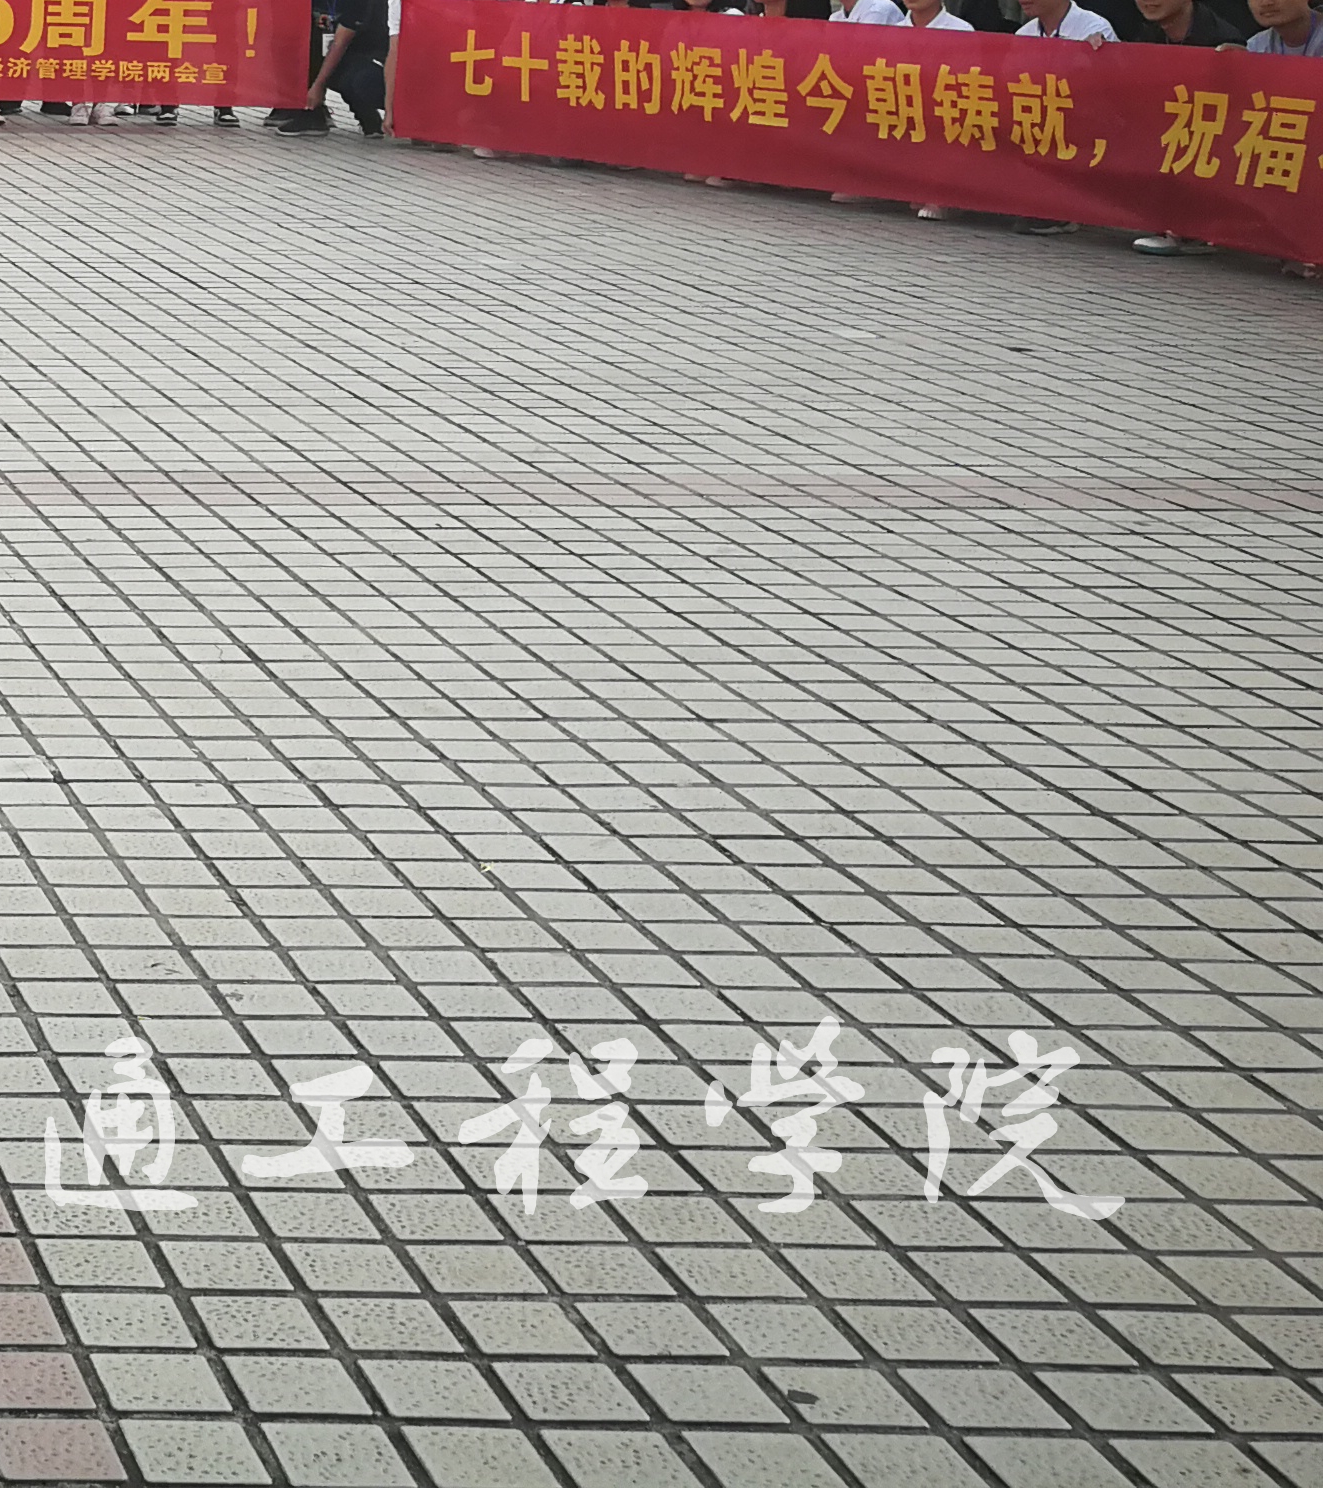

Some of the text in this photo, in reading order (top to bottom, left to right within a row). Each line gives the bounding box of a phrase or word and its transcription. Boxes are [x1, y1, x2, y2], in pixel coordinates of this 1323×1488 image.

[450, 29, 1323, 194] 七十载的辉煌今朝铸就，祝福
